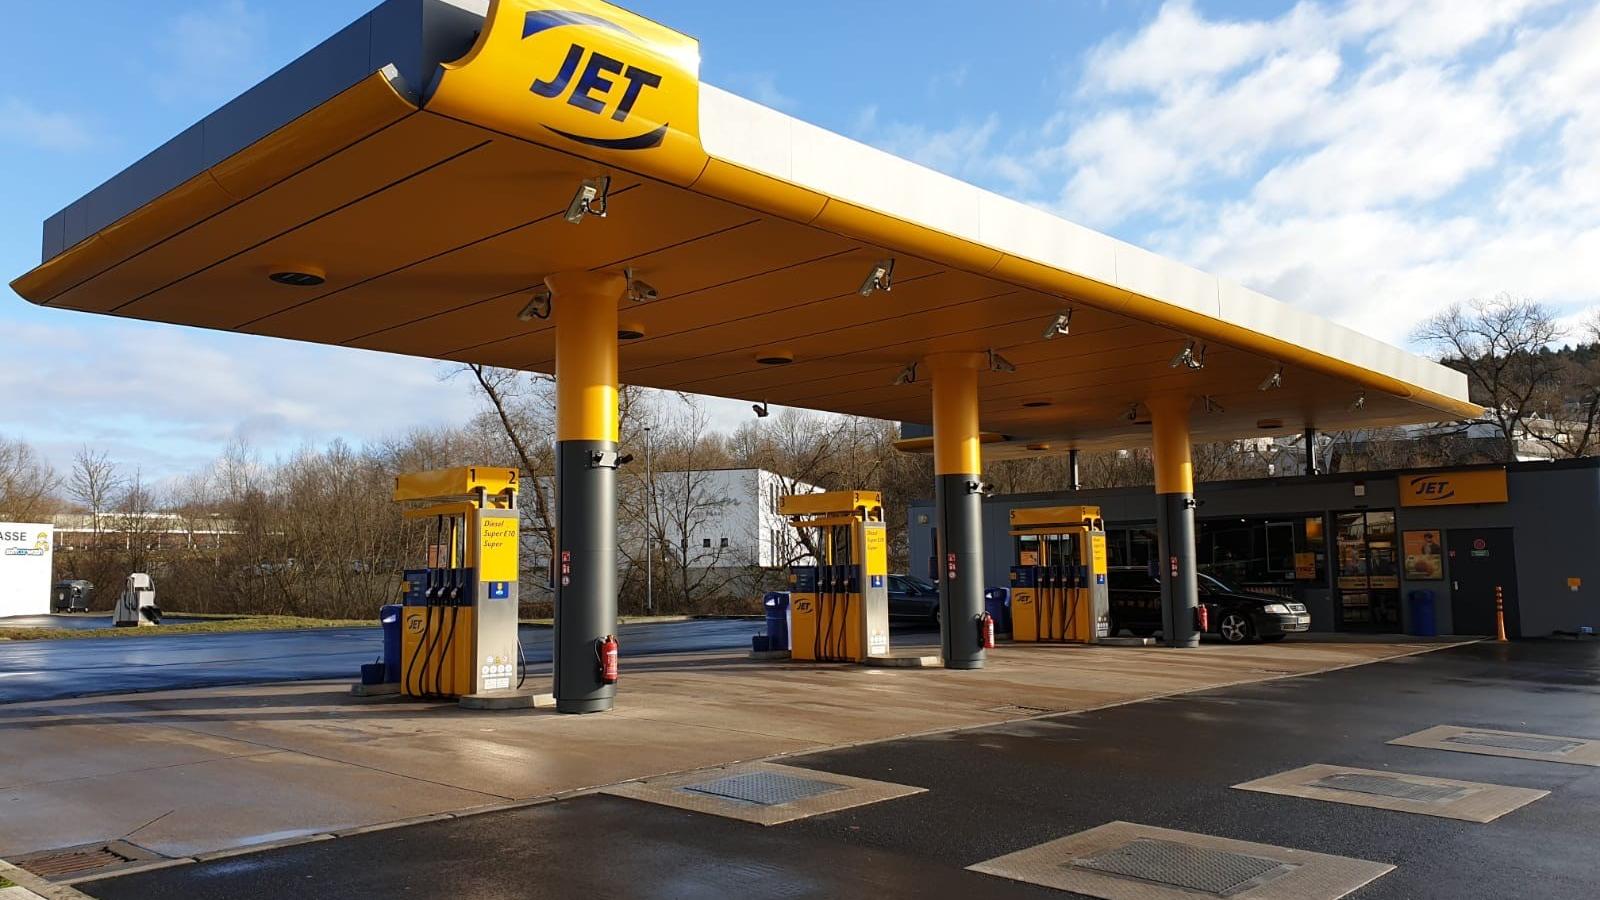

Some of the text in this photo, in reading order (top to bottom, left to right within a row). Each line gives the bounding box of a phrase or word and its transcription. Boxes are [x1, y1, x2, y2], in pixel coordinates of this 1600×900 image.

[529, 43, 662, 122] JET
[469, 469, 476, 482] 1
[508, 471, 516, 484] 2
[1415, 480, 1449, 495] JET
[1010, 510, 1016, 519] 5
[483, 540, 503, 550] Super
